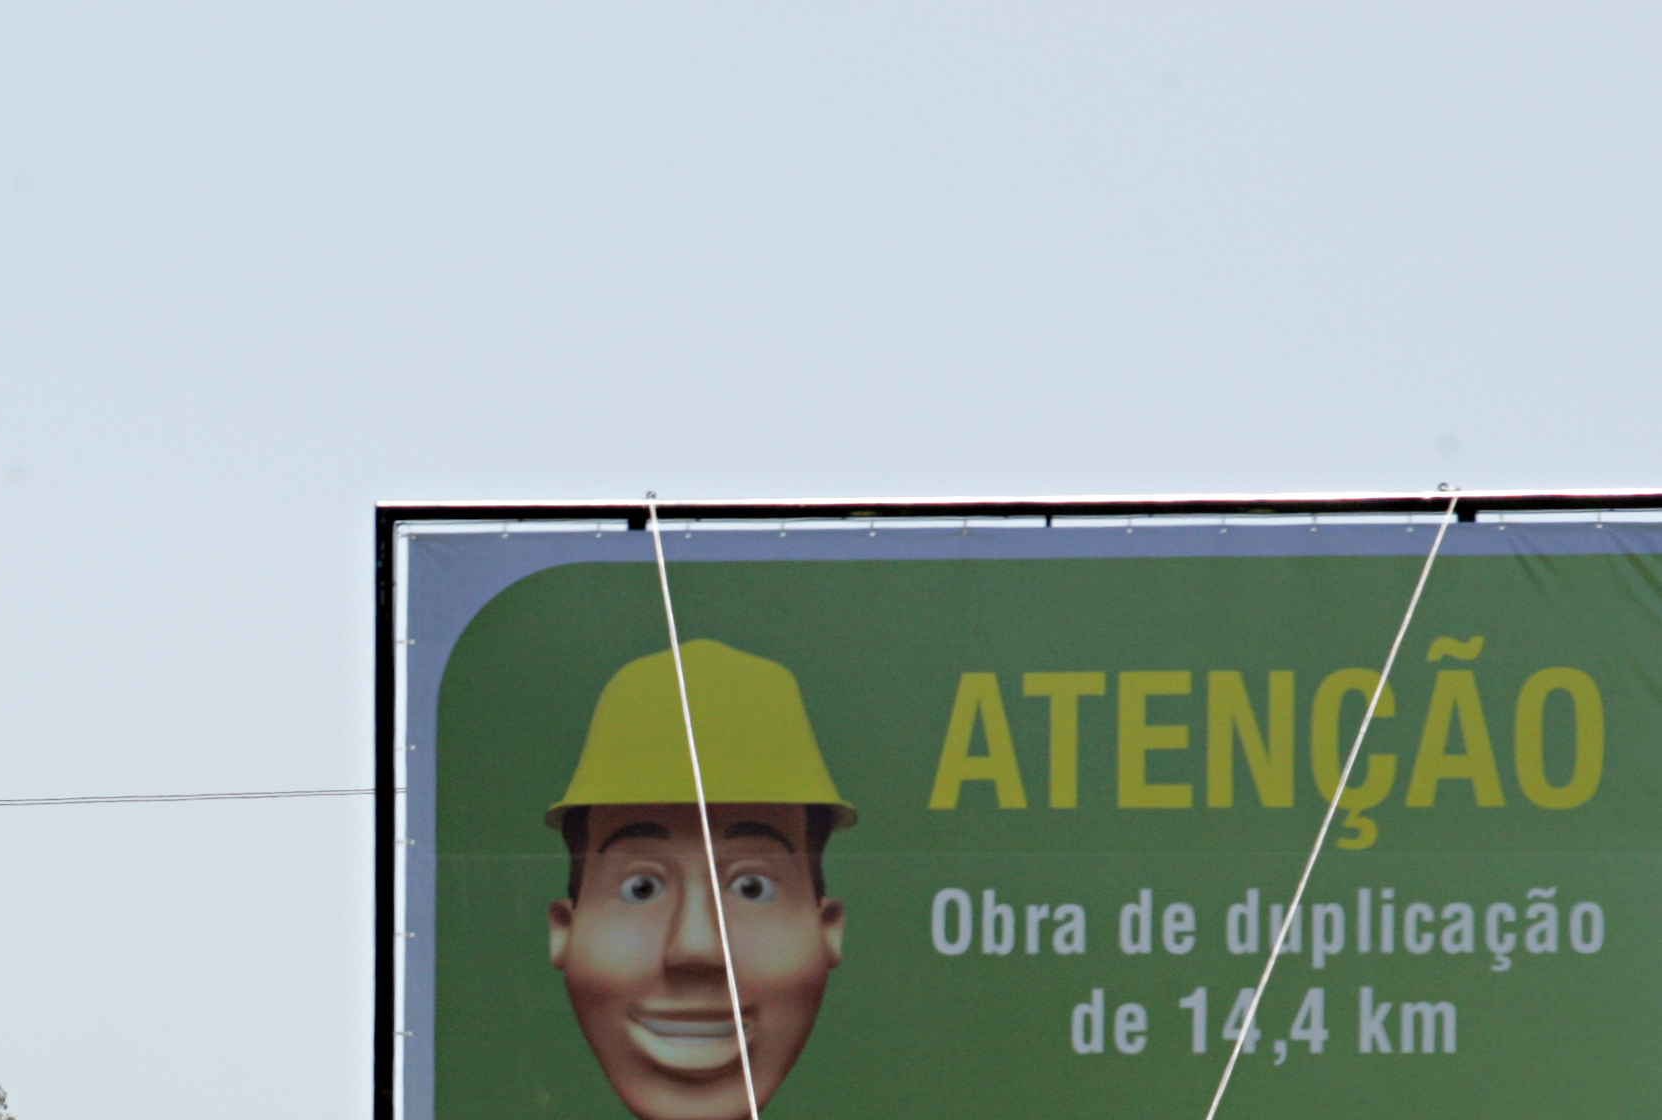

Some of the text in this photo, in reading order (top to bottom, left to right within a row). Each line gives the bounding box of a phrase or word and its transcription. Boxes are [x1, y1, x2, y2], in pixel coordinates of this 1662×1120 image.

[928, 635, 1606, 851] ATENÇÃO
[930, 885, 1606, 972] Obra de duplicação
[1070, 986, 1458, 1067] de 14,4 km
